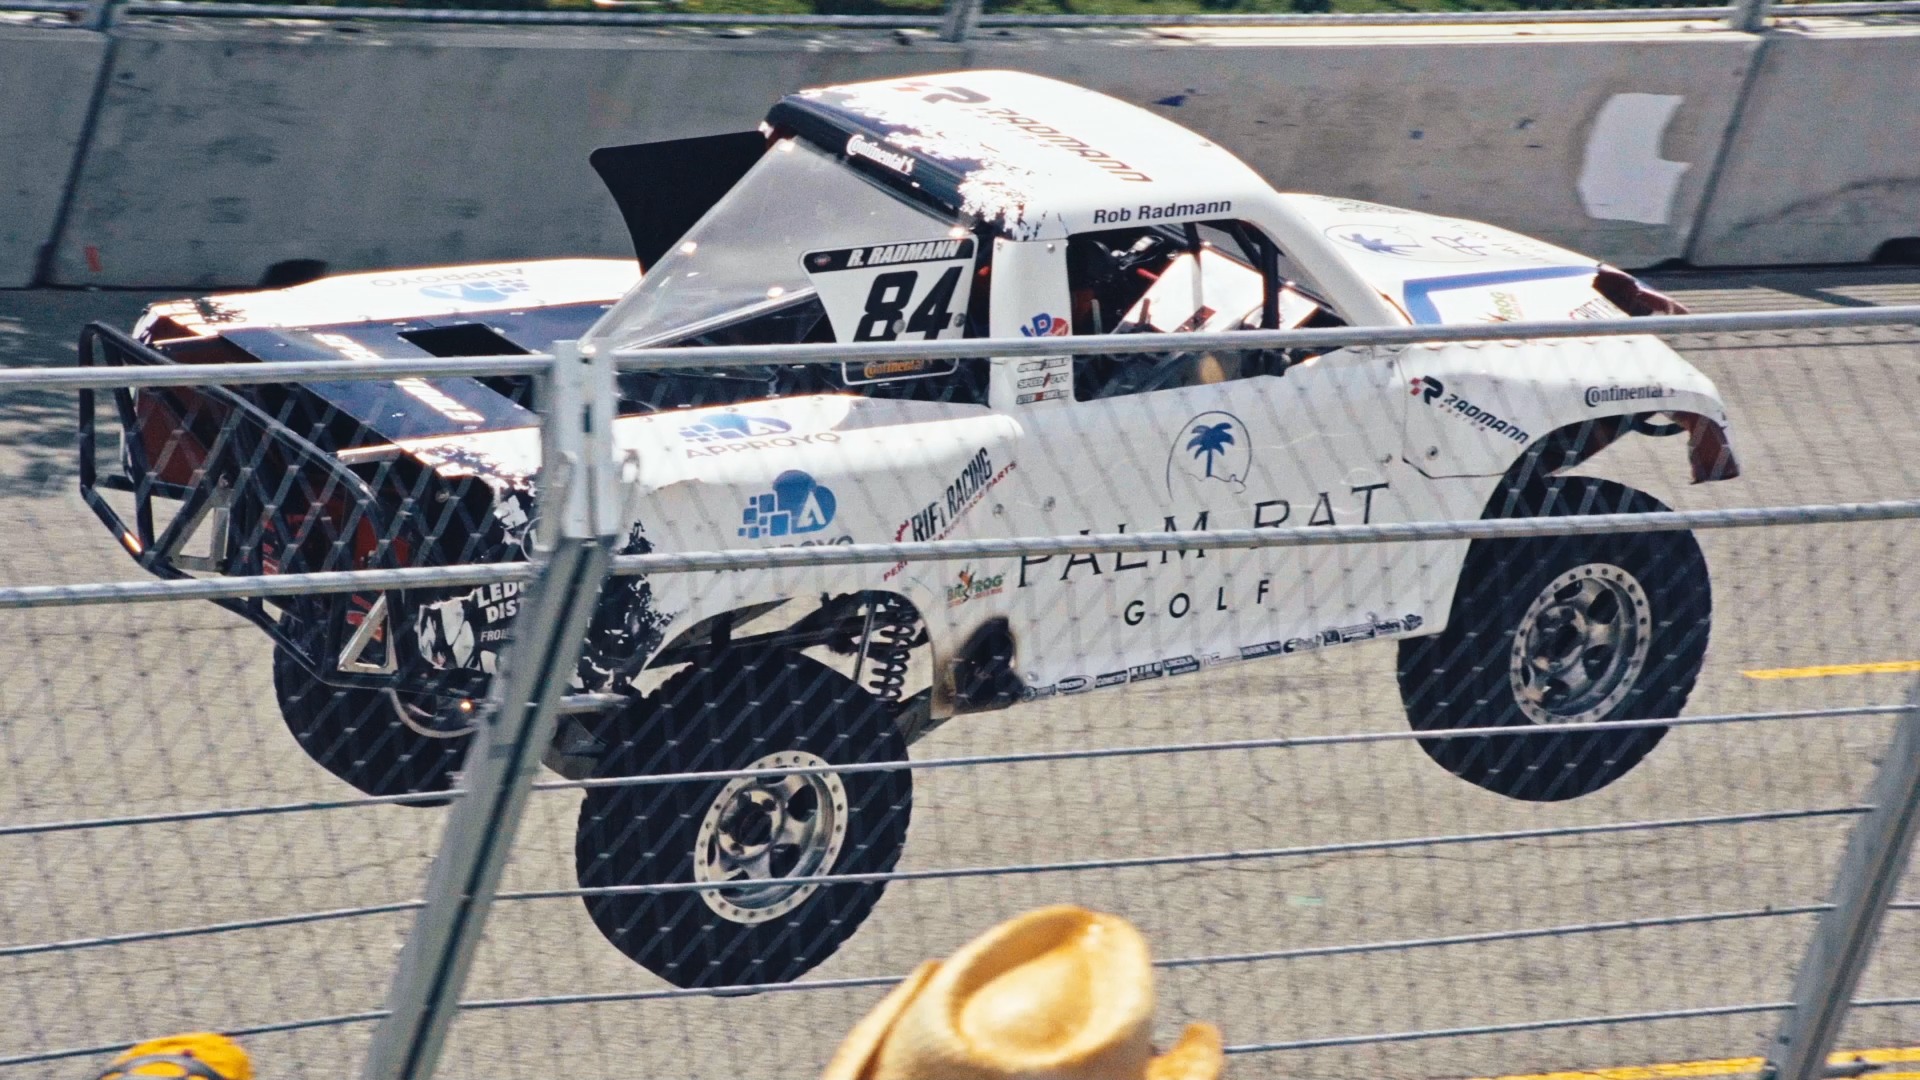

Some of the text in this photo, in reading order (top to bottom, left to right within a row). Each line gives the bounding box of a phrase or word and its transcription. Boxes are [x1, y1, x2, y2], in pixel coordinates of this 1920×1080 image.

[1094, 200, 1232, 224] Rob Radmann
[846, 249, 864, 267] R.
[867, 239, 962, 266] RADMANN
[853, 266, 963, 342] 84
[1584, 383, 1664, 407] Continental
[1444, 393, 1529, 444] RADMANN
[686, 432, 841, 459] APPROYO
[946, 447, 993, 519] RACING
[1124, 579, 1270, 625] GOLF
